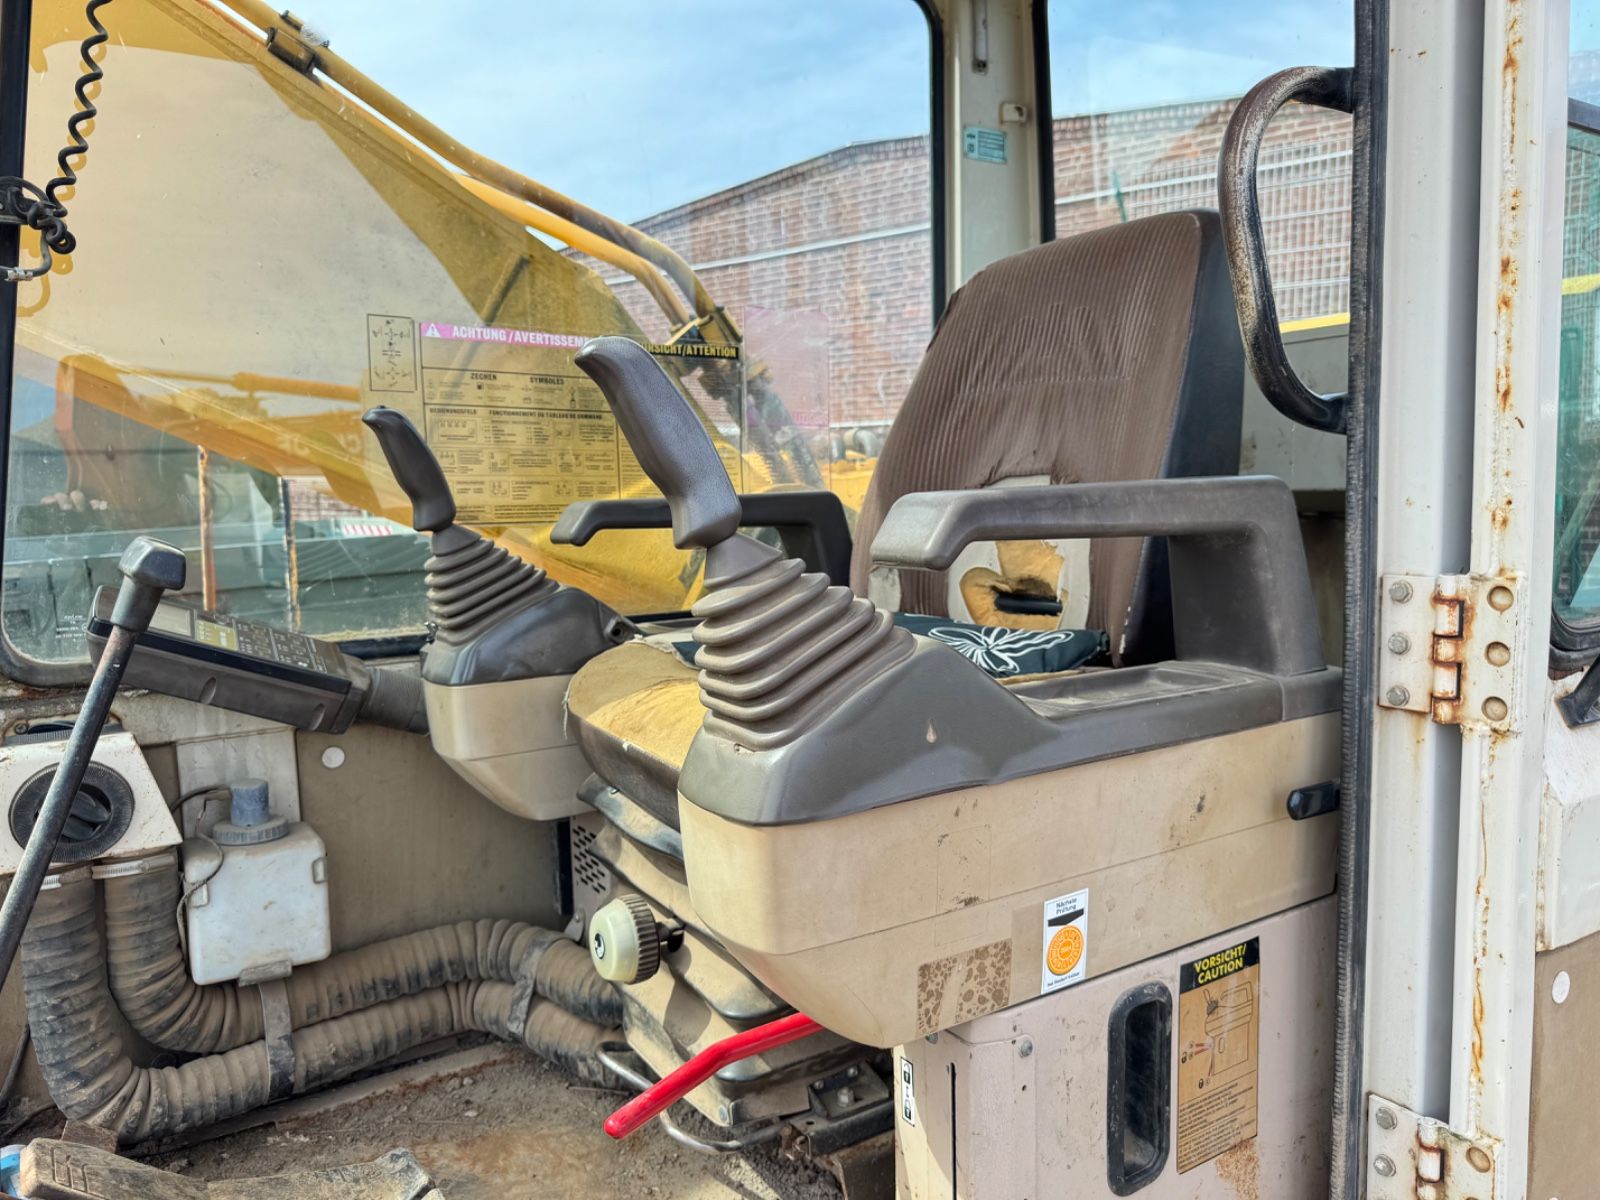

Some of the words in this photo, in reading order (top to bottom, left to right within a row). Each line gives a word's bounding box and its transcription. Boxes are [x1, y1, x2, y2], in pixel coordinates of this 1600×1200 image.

[529, 376, 564, 385] SYMBOLES
[1194, 943, 1247, 973] VORSICHT/
[1198, 957, 1243, 984] CAUTION
